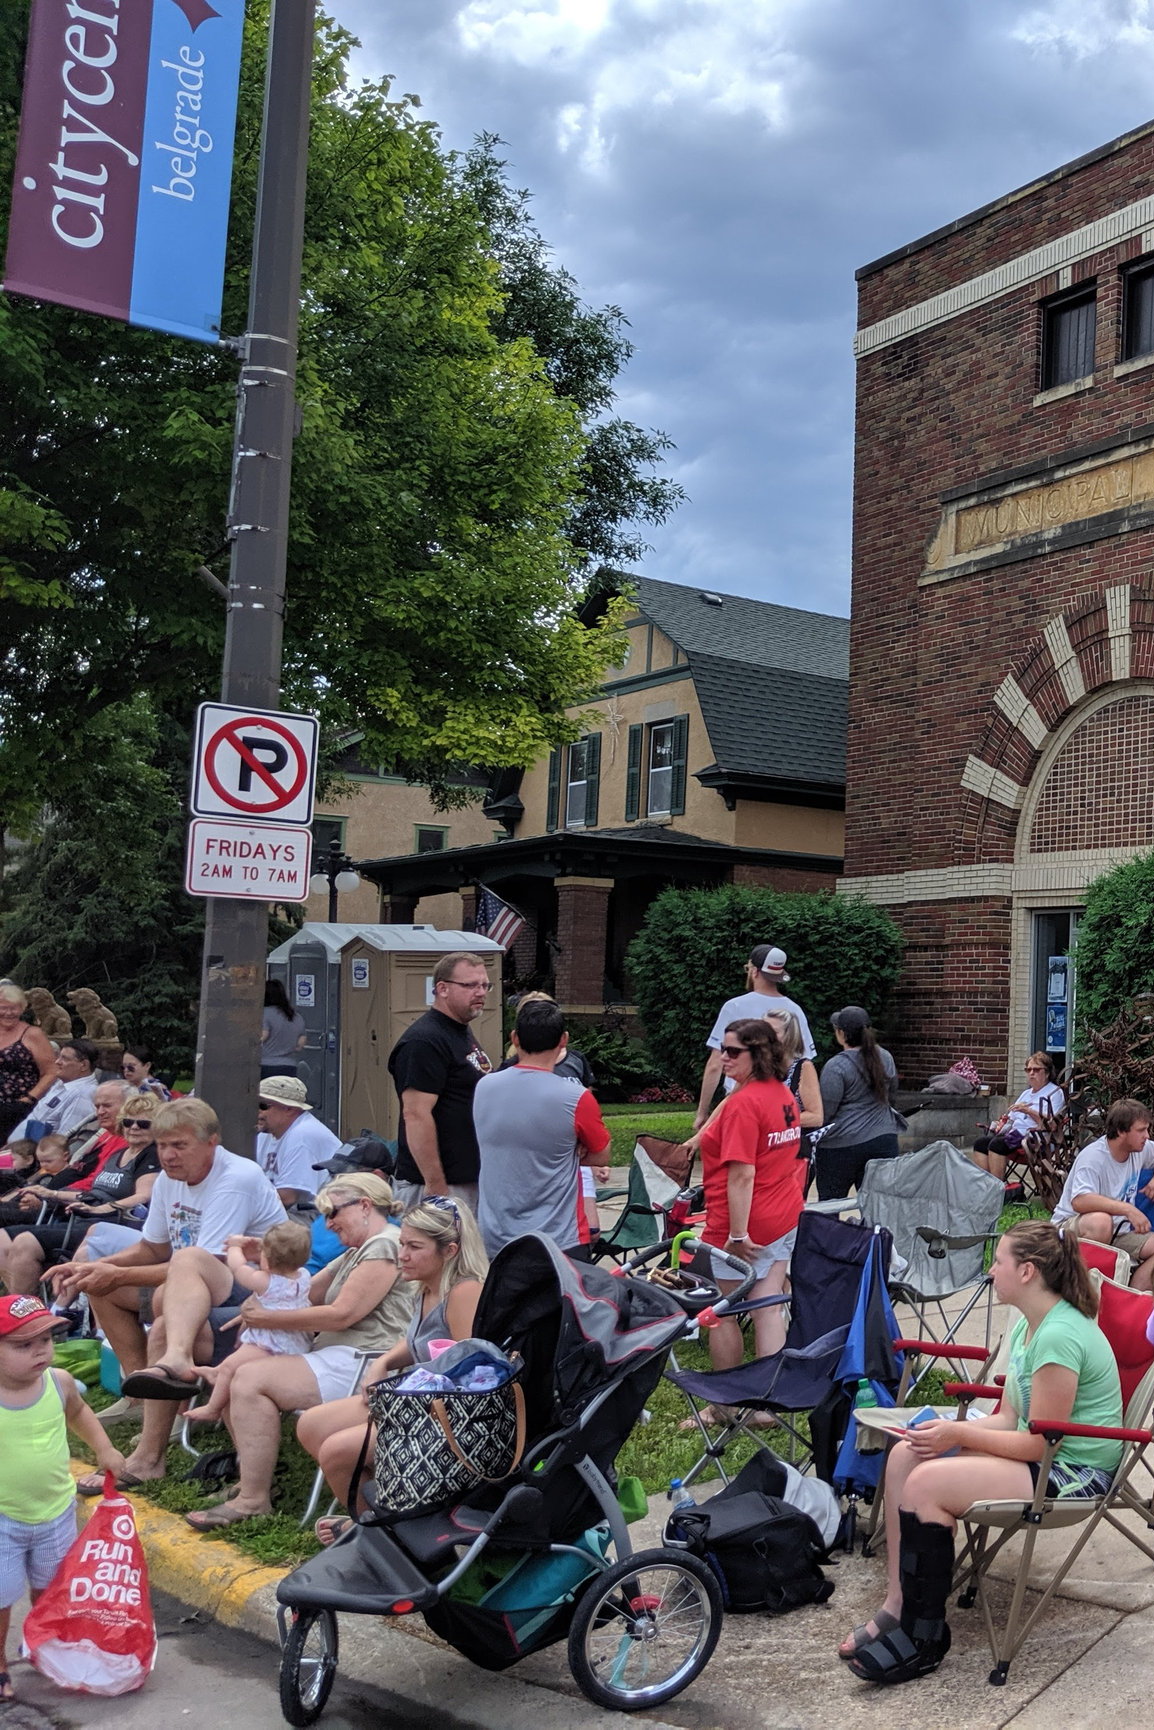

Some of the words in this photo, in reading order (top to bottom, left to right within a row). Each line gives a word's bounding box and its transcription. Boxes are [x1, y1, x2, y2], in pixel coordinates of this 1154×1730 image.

[152, 45, 213, 202] belgrade
[968, 467, 1131, 543] MUNICIPAL
[238, 735, 289, 792] P
[205, 838, 296, 862] FRIDAYS
[200, 862, 233, 879] 2AM
[242, 866, 259, 880] TO
[268, 868, 298, 883] 7AM
[80, 1540, 133, 1563] Run
[95, 1562, 142, 1586] and
[70, 1577, 141, 1606] Done
